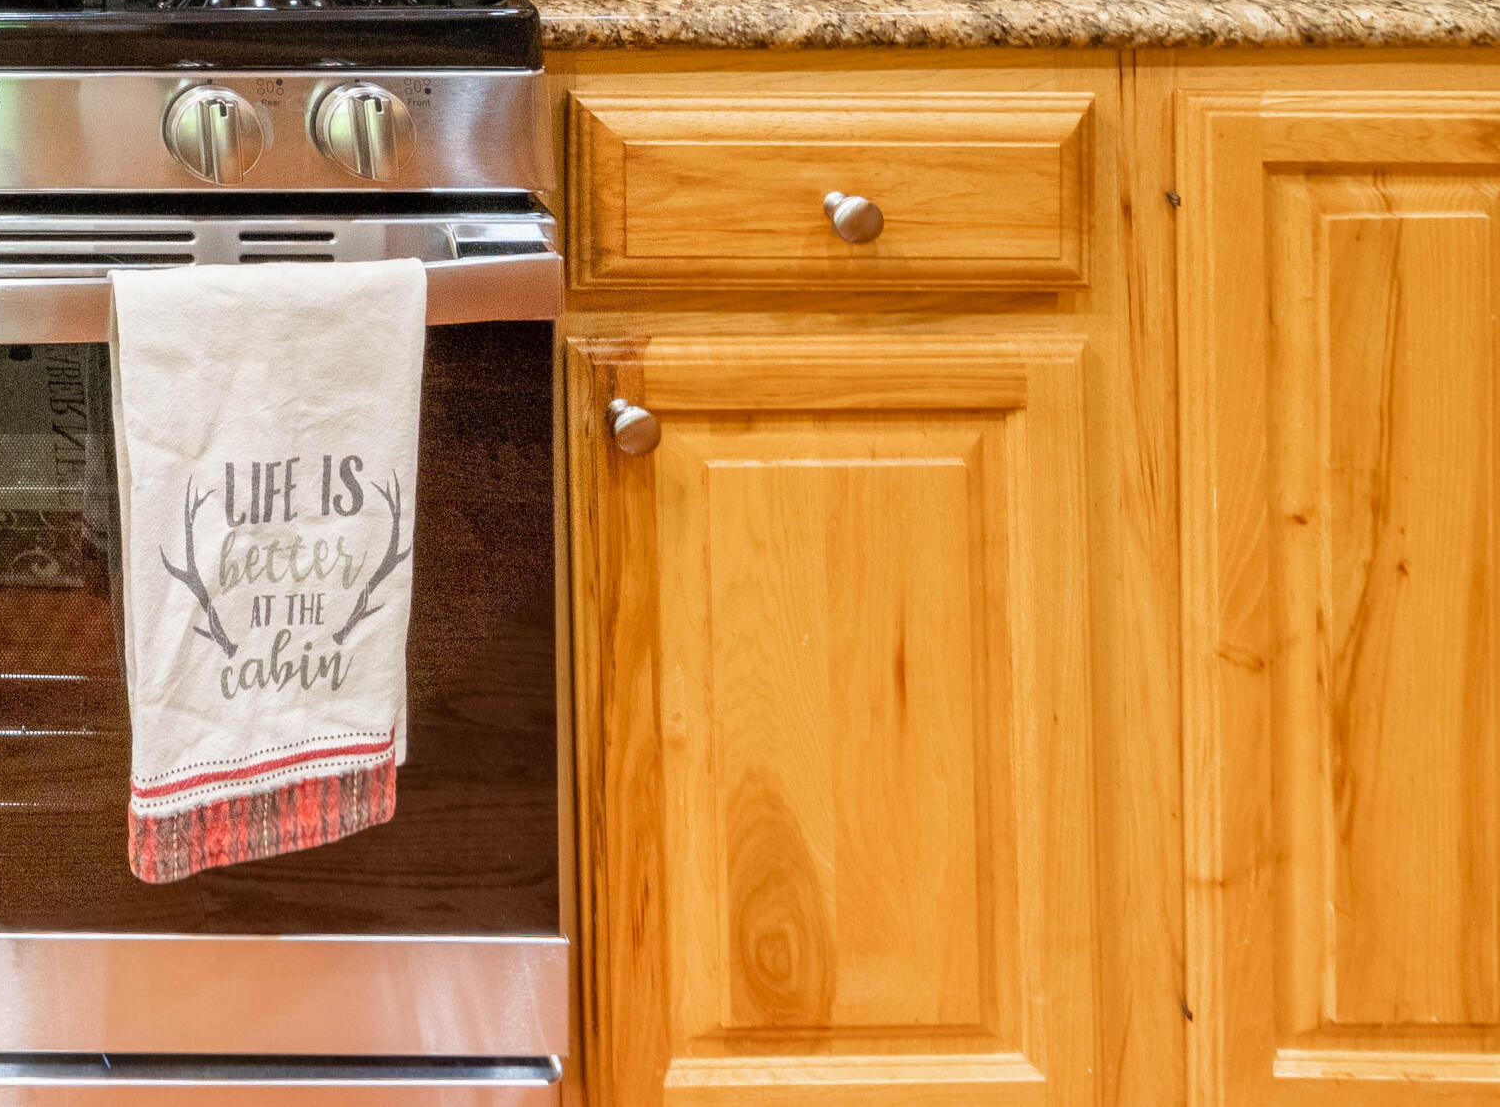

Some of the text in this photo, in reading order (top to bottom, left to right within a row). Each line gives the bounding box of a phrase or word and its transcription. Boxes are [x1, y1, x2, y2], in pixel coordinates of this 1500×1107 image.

[261, 98, 281, 106] Rear
[407, 98, 431, 106] Front
[225, 454, 365, 528] LIFE IS
[218, 530, 368, 595] better
[250, 593, 326, 629] AT THE
[220, 628, 355, 701] cabin
